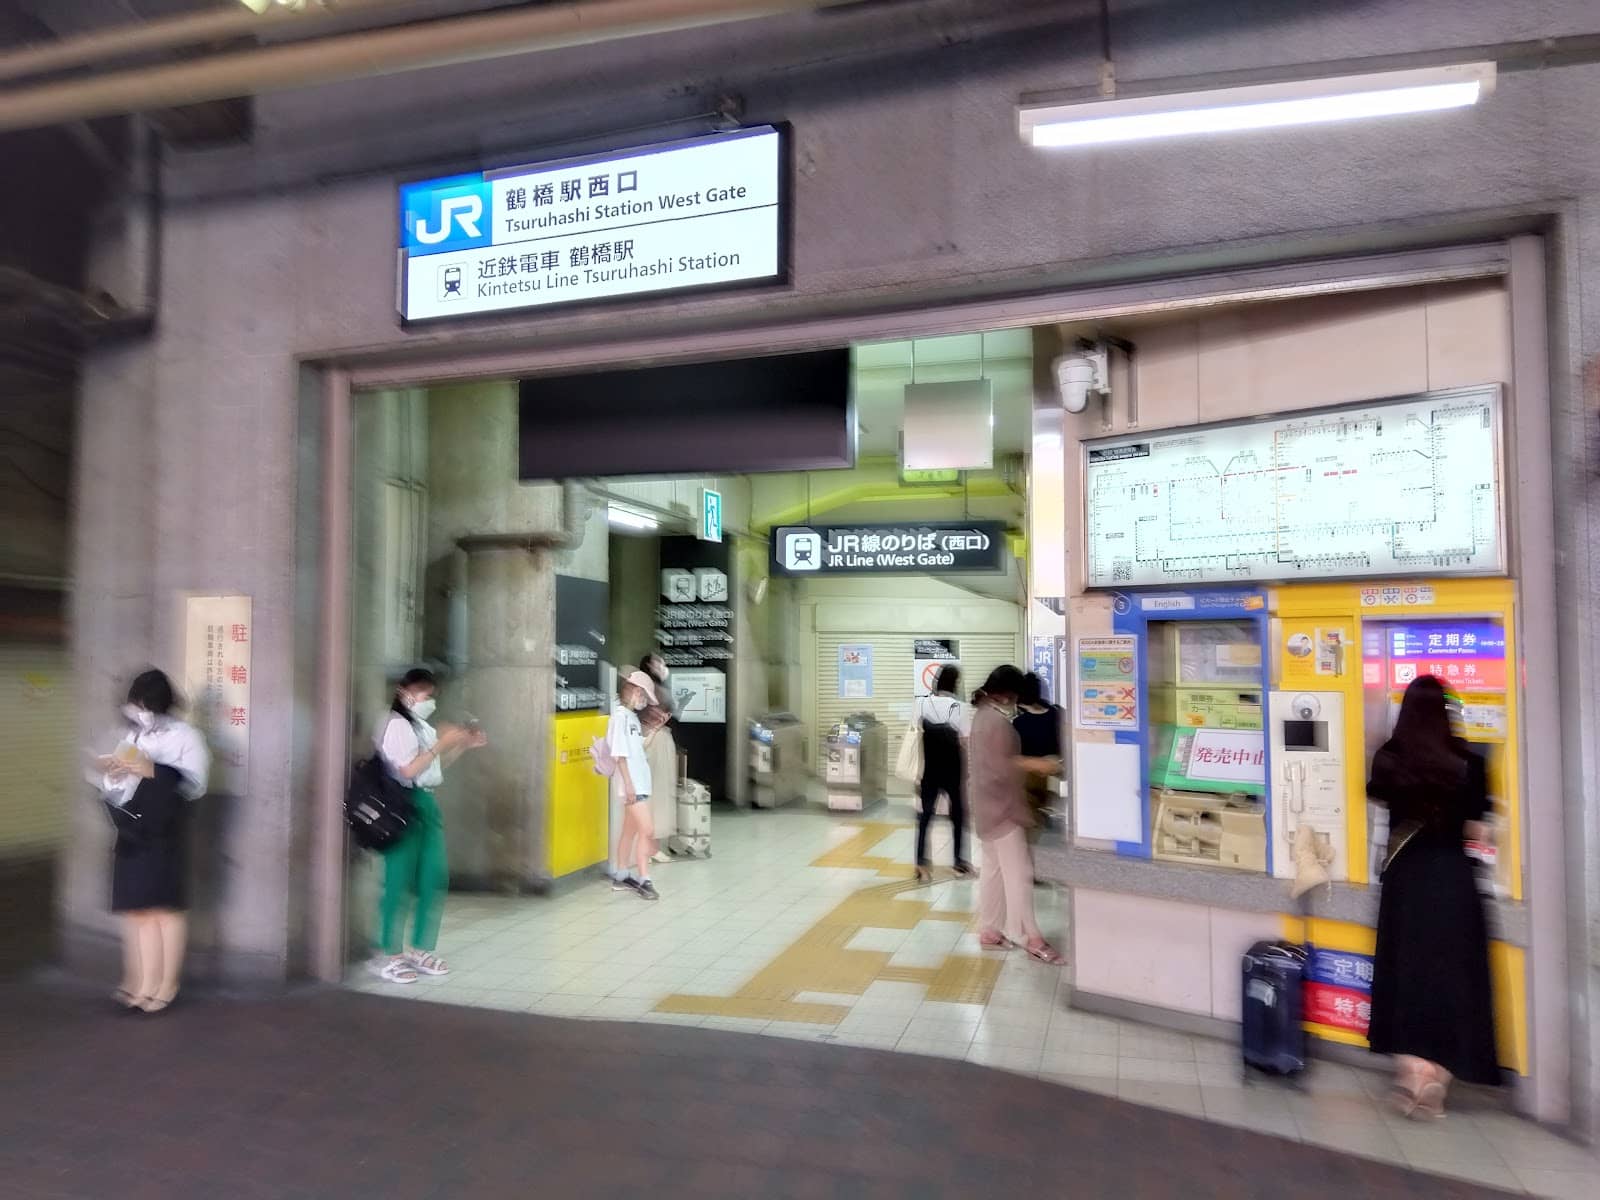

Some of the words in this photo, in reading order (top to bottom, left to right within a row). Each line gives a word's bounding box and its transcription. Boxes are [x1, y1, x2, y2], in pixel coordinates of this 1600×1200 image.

[505, 170, 638, 211] 鶴橋駅西口
[415, 193, 483, 245] JR
[505, 206, 590, 233] Tsuruhashi
[595, 197, 654, 221] Station
[658, 192, 701, 214] West
[706, 183, 746, 205] Gate
[477, 249, 561, 280] 近鉄電車
[569, 239, 635, 269] 鶴橋駅
[477, 276, 541, 298] Kintetsu
[546, 271, 579, 289] Line
[584, 261, 673, 286] Tsuruhashi
[678, 250, 741, 273] Station
[828, 555, 843, 567] JR
[846, 554, 874, 567] Line
[876, 553, 915, 569] (West
[918, 552, 955, 567] Gate)
[1428, 633, 1477, 647] 定期券
[1036, 651, 1051, 664] JR
[1429, 663, 1477, 677] 特急券
[1196, 746, 1265, 766] 発売中止
